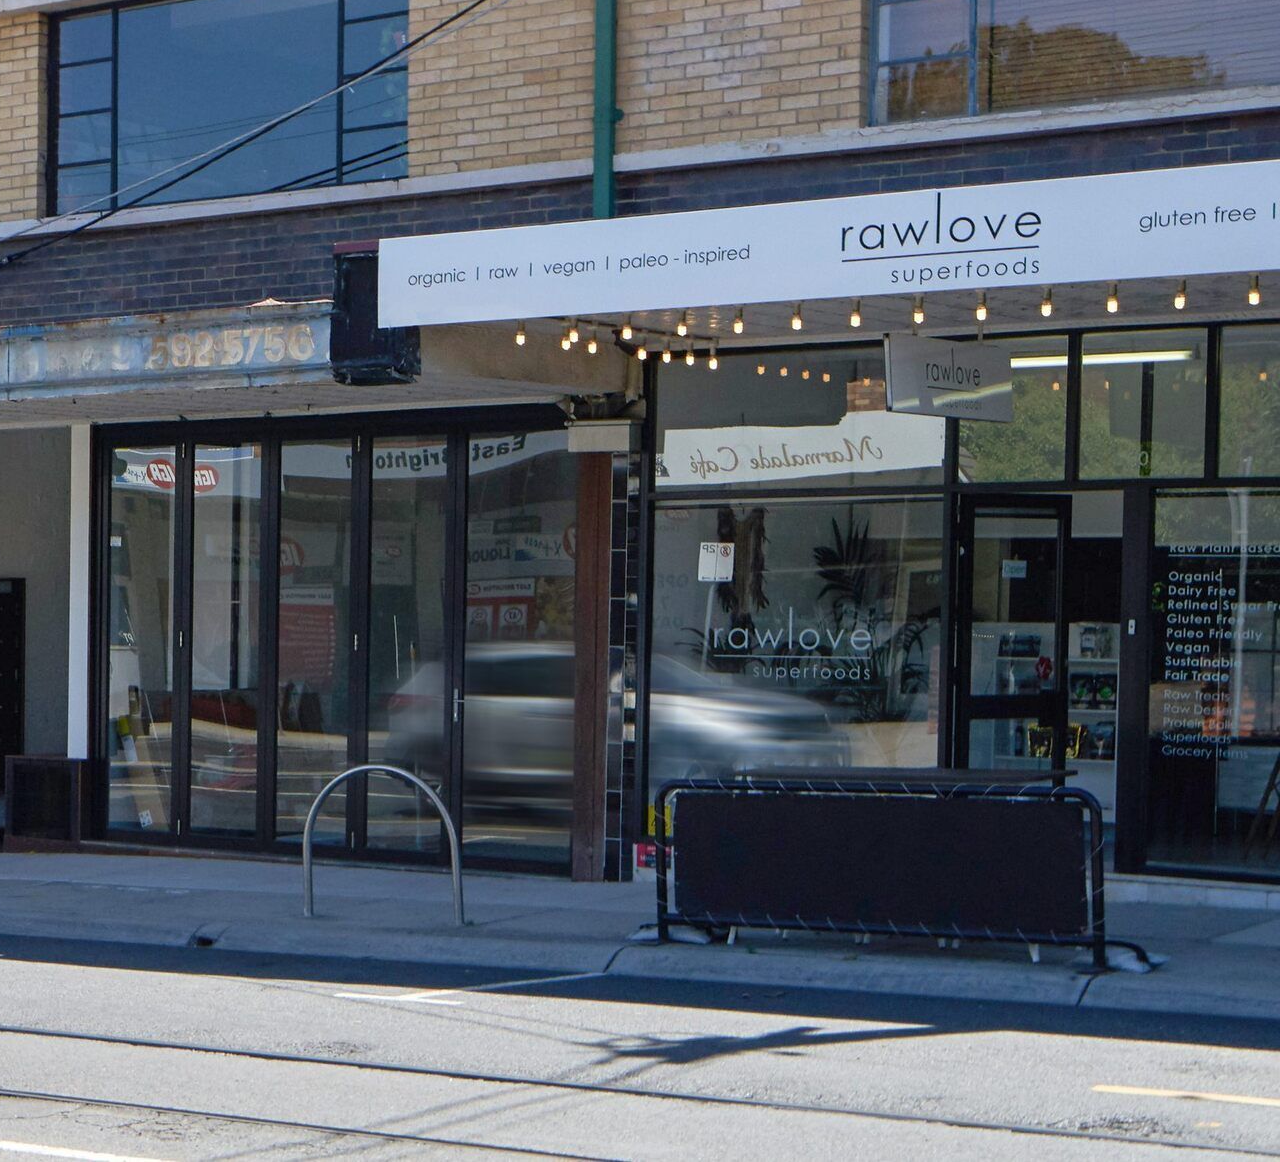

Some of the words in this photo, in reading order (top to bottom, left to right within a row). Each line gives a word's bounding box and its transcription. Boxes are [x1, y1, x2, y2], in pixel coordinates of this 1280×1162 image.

[841, 192, 1041, 252] rawlove
[1139, 206, 1207, 232] gluten
[1214, 205, 1257, 225] free
[407, 268, 466, 288] organic
[489, 266, 519, 280] raw
[543, 259, 596, 277] vegan
[619, 251, 669, 273] paleo
[684, 243, 751, 268] inspired
[890, 257, 1040, 285] superfoods
[925, 347, 981, 387] rawlove
[1168, 570, 1223, 583] Organic
[1168, 585, 1203, 598] Dairy
[1207, 585, 1236, 596] Free
[1167, 599, 1218, 611] Refined
[1166, 613, 1211, 625] Gluten
[713, 605, 872, 651] rawlove
[1166, 627, 1204, 639] Paleo
[1165, 641, 1210, 654] Vegan
[1165, 655, 1241, 668] Sustainable
[752, 664, 871, 681] superfoods
[1164, 670, 1188, 681] Fair
[1191, 670, 1230, 682] Trade
[1164, 689, 1191, 699] Raw
[1163, 703, 1191, 714] Raw
[1162, 730, 1232, 744] Superfoods
[1161, 745, 1213, 758] Grocery
